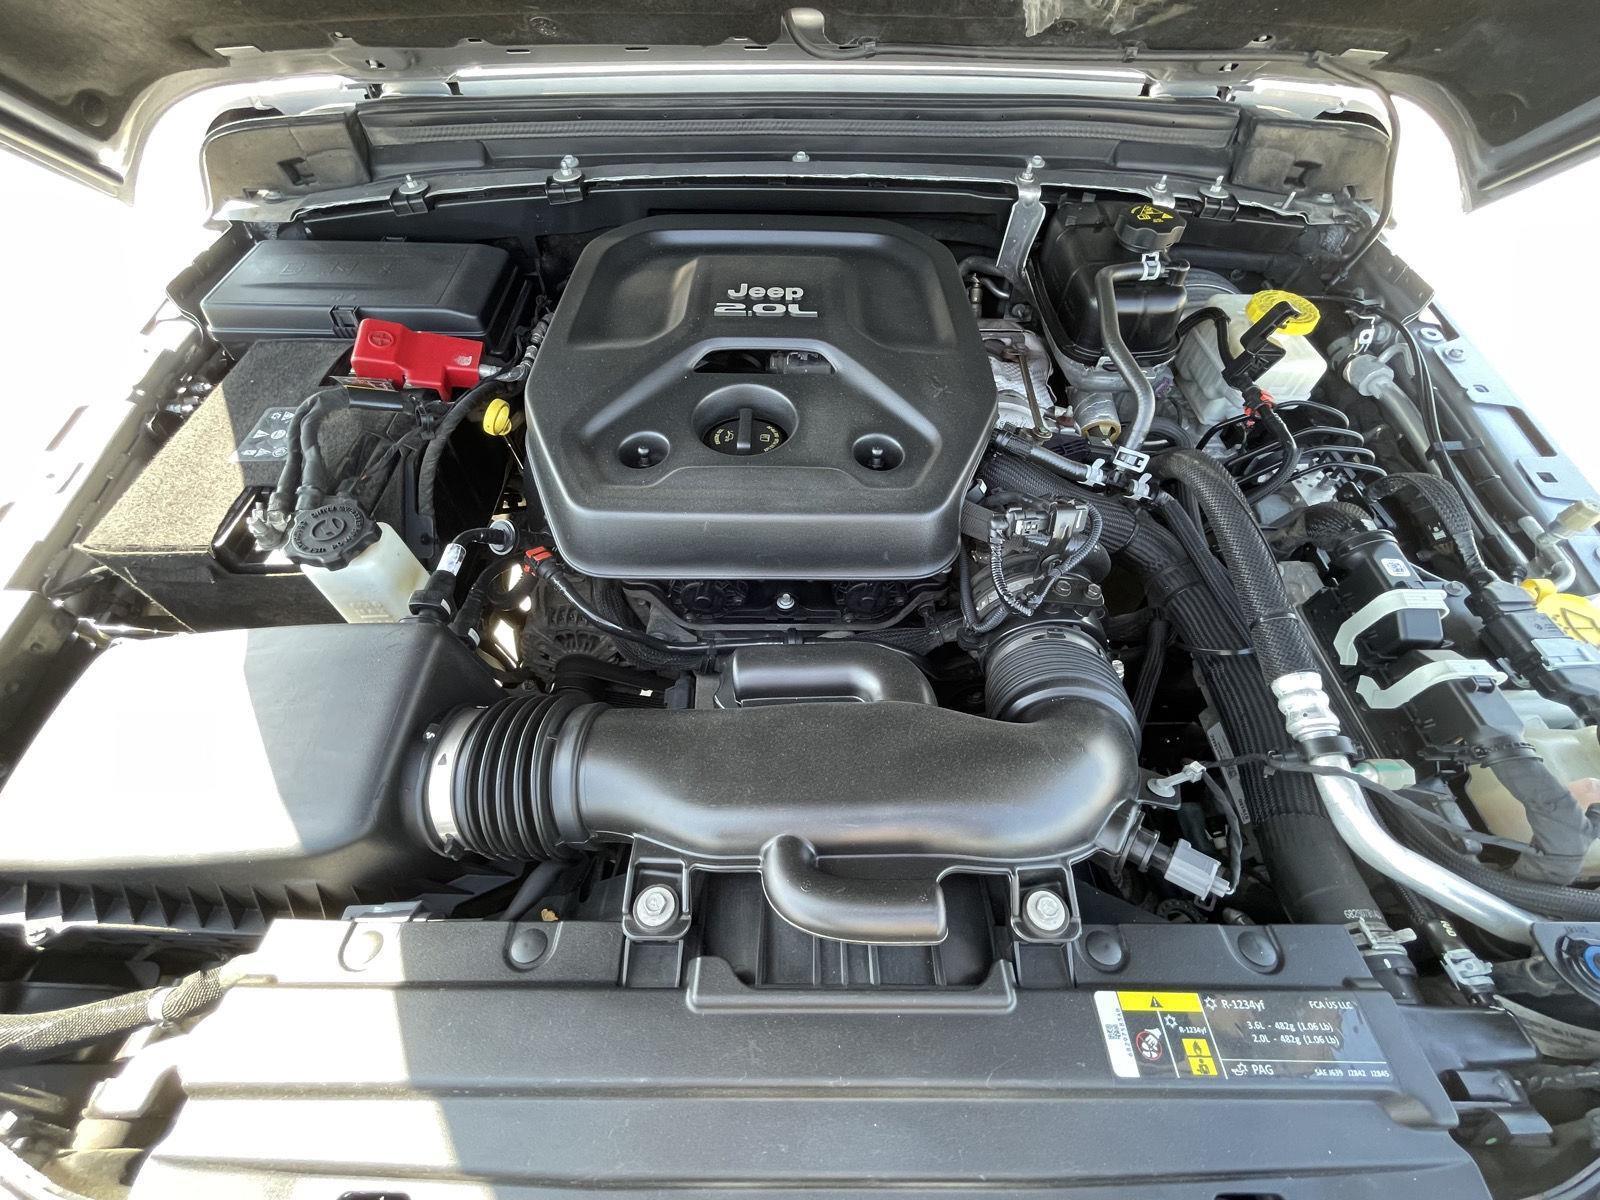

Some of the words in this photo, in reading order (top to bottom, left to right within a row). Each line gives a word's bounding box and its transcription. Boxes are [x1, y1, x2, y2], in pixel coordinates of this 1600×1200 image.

[727, 283, 804, 302] Jeep
[714, 303, 818, 317] 2.0L
[1221, 999, 1265, 1011] R-1234yf
[1309, 1000, 1325, 1009] FCA
[1326, 1001, 1337, 1009] US
[1338, 1001, 1353, 1010] LLC
[1178, 1026, 1207, 1035] R-1234yf
[1246, 1021, 1265, 1030] 3.6L
[1275, 1021, 1296, 1032] 482g
[1252, 1034, 1270, 1044] 2.0L
[1280, 1034, 1302, 1045] 482g
[1251, 1064, 1275, 1076] PAG
[1314, 1068, 1328, 1077] SAE
